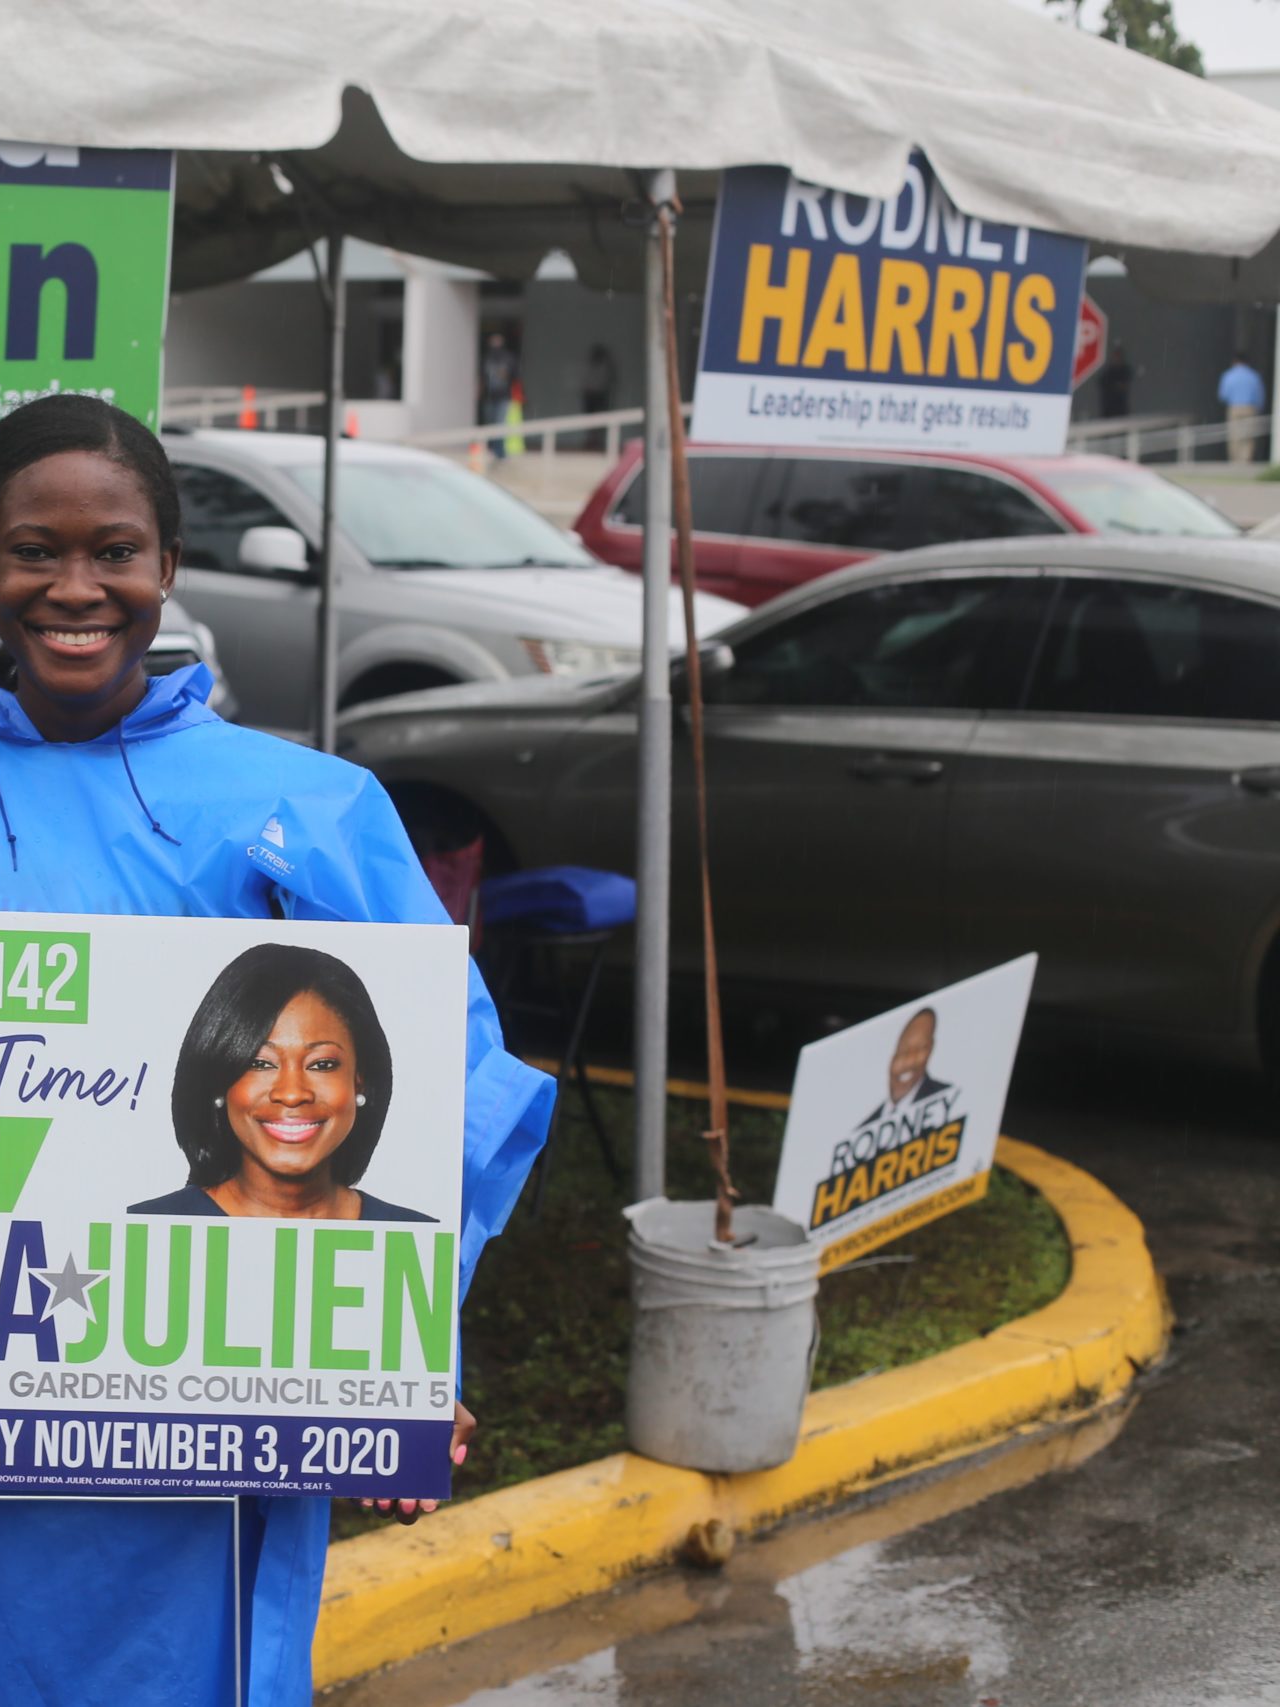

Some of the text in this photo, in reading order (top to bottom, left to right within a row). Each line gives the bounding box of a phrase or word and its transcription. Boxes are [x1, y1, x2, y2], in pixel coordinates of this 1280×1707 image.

[737, 243, 1056, 385] HARRIS
[747, 385, 1030, 431] Leadership that gets results
[830, 1088, 961, 1177] RODNEY
[813, 1120, 962, 1226] HARRIS
[65, 1222, 455, 1373] JULIEN
[9, 1371, 167, 1401] GARDENS
[178, 1375, 328, 1406] COUNCIL
[338, 1379, 419, 1408] SEAT
[429, 1381, 449, 1409] 5
[26, 1475, 38, 1483] BY
[39, 1476, 63, 1484] LINDA
[95, 1477, 142, 1486] CANDIDATE
[144, 1478, 160, 1486] FOR
[162, 1478, 181, 1487] CITY
[182, 1479, 194, 1487] OF
[195, 1480, 221, 1488] MIAMI
[222, 1480, 261, 1489] GARDENS
[303, 1482, 324, 1490] SEAT
[34, 1419, 244, 1472] NOVEMBER
[254, 1424, 288, 1480] 3,
[301, 1426, 400, 1476] 2020
